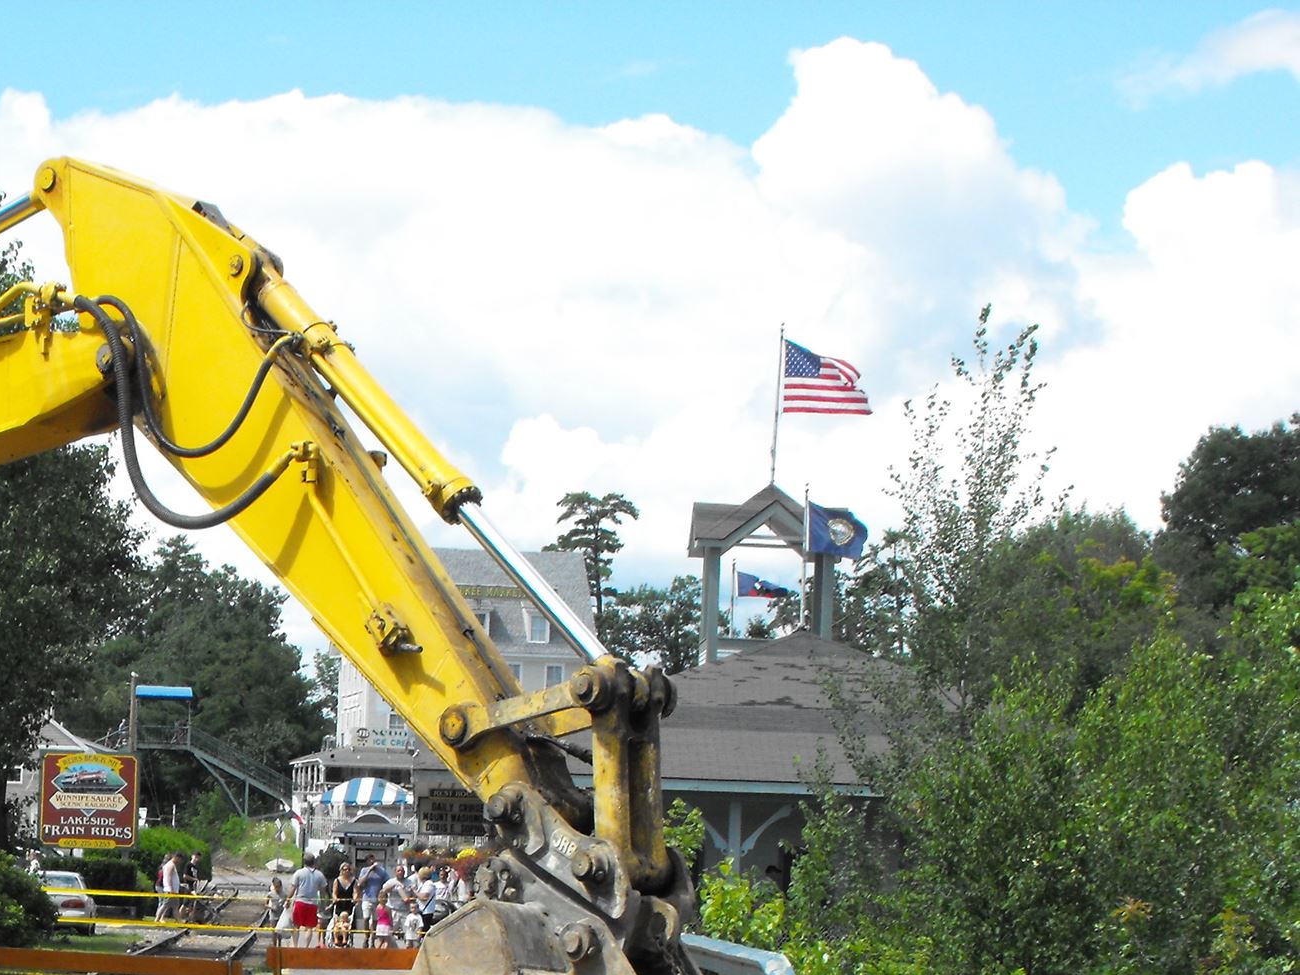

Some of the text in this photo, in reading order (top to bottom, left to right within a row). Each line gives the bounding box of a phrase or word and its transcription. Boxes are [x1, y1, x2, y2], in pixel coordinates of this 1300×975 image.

[60, 816, 116, 826] LAKESIDE
[422, 812, 448, 822] MOUNT
[42, 824, 133, 839] TRAIN RIDES
